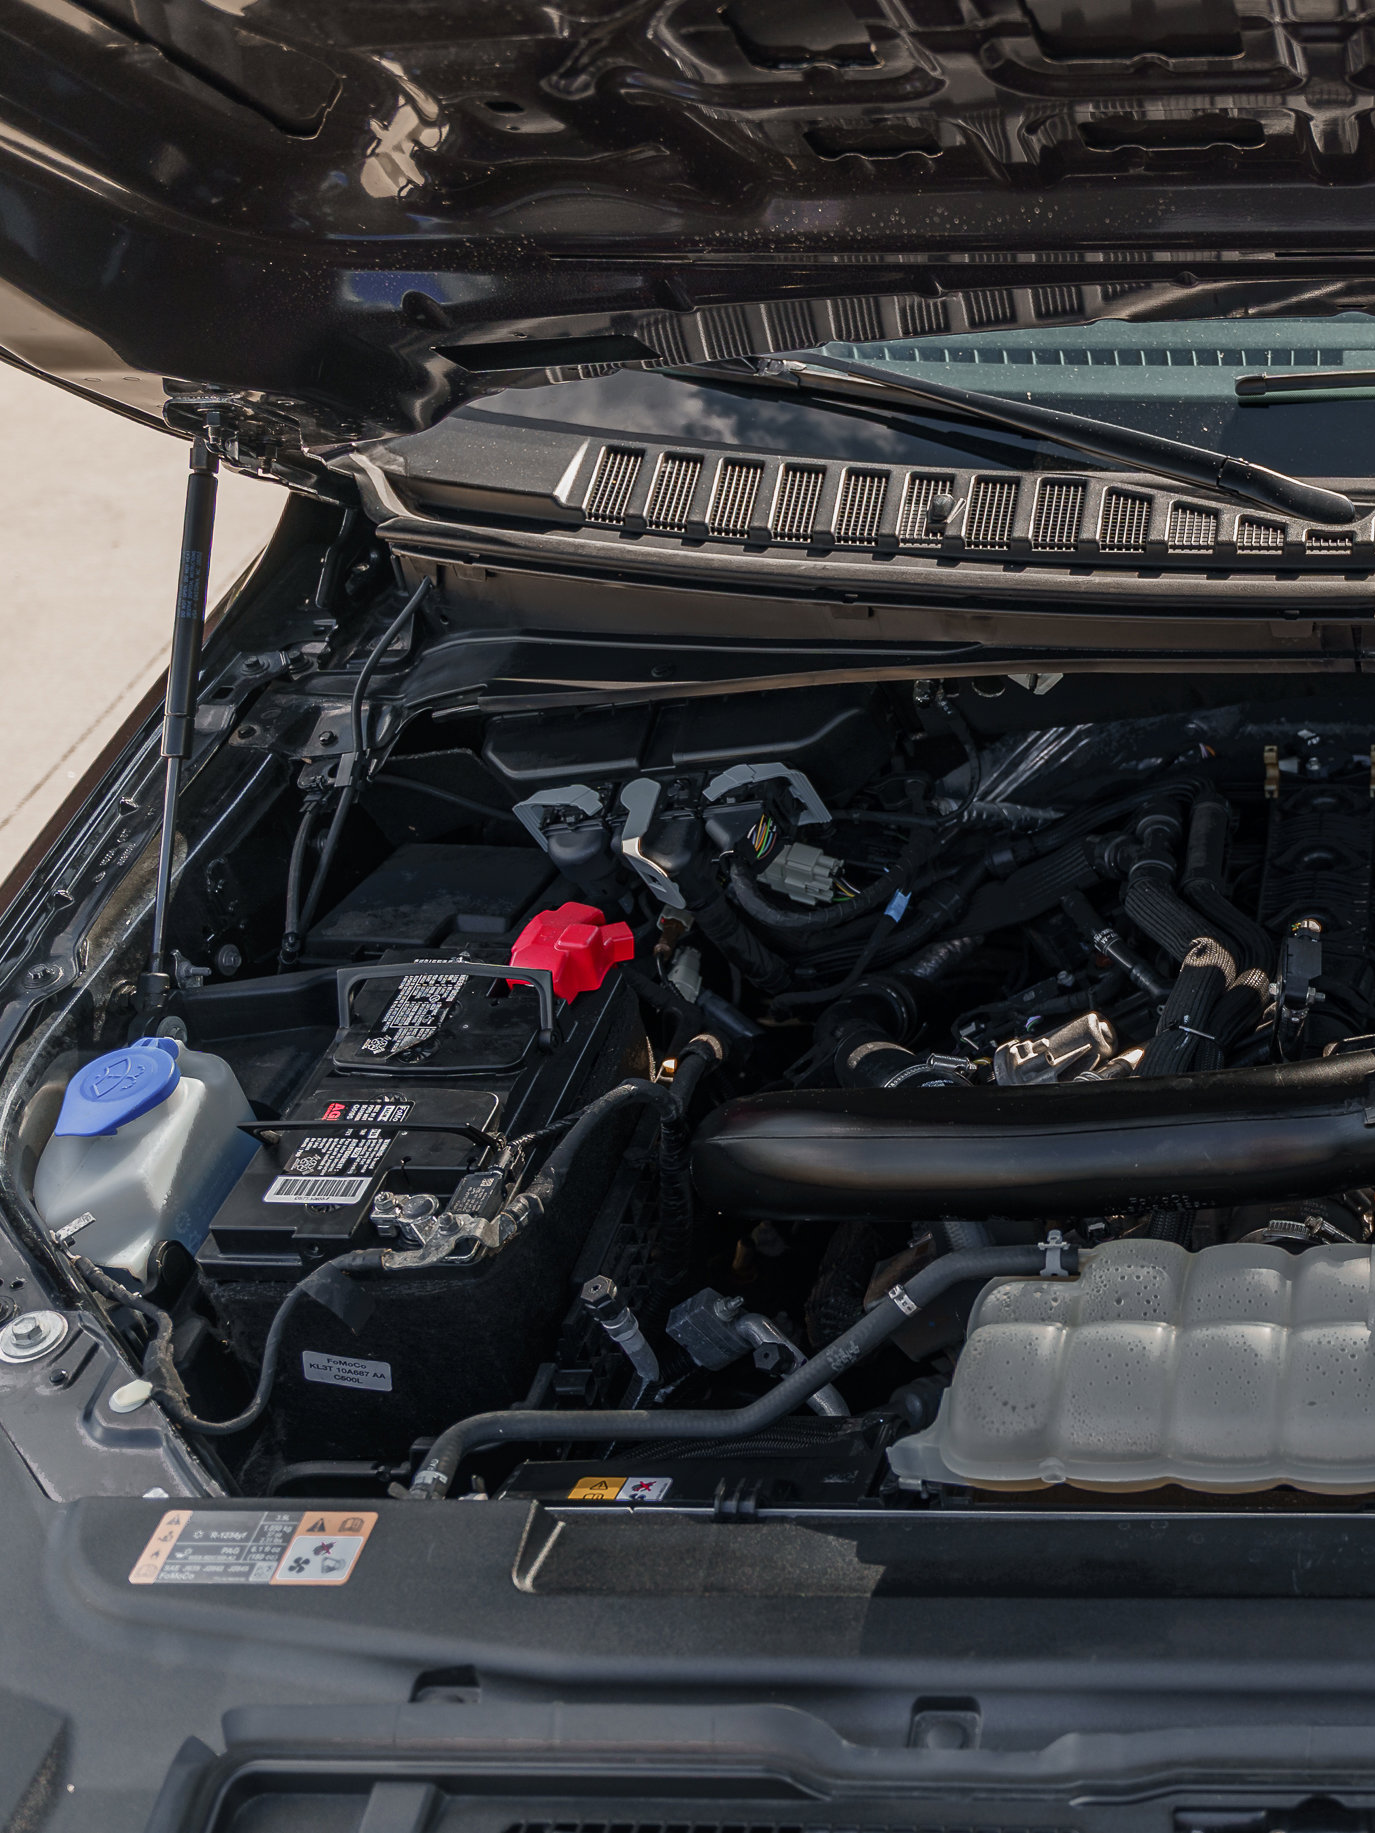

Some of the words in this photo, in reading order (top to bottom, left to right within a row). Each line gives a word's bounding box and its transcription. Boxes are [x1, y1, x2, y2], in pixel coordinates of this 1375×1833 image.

[309, 1363, 333, 1371] KL3T
[326, 1358, 367, 1369] FoMoCo
[159, 1571, 196, 1580] FoMoCo
